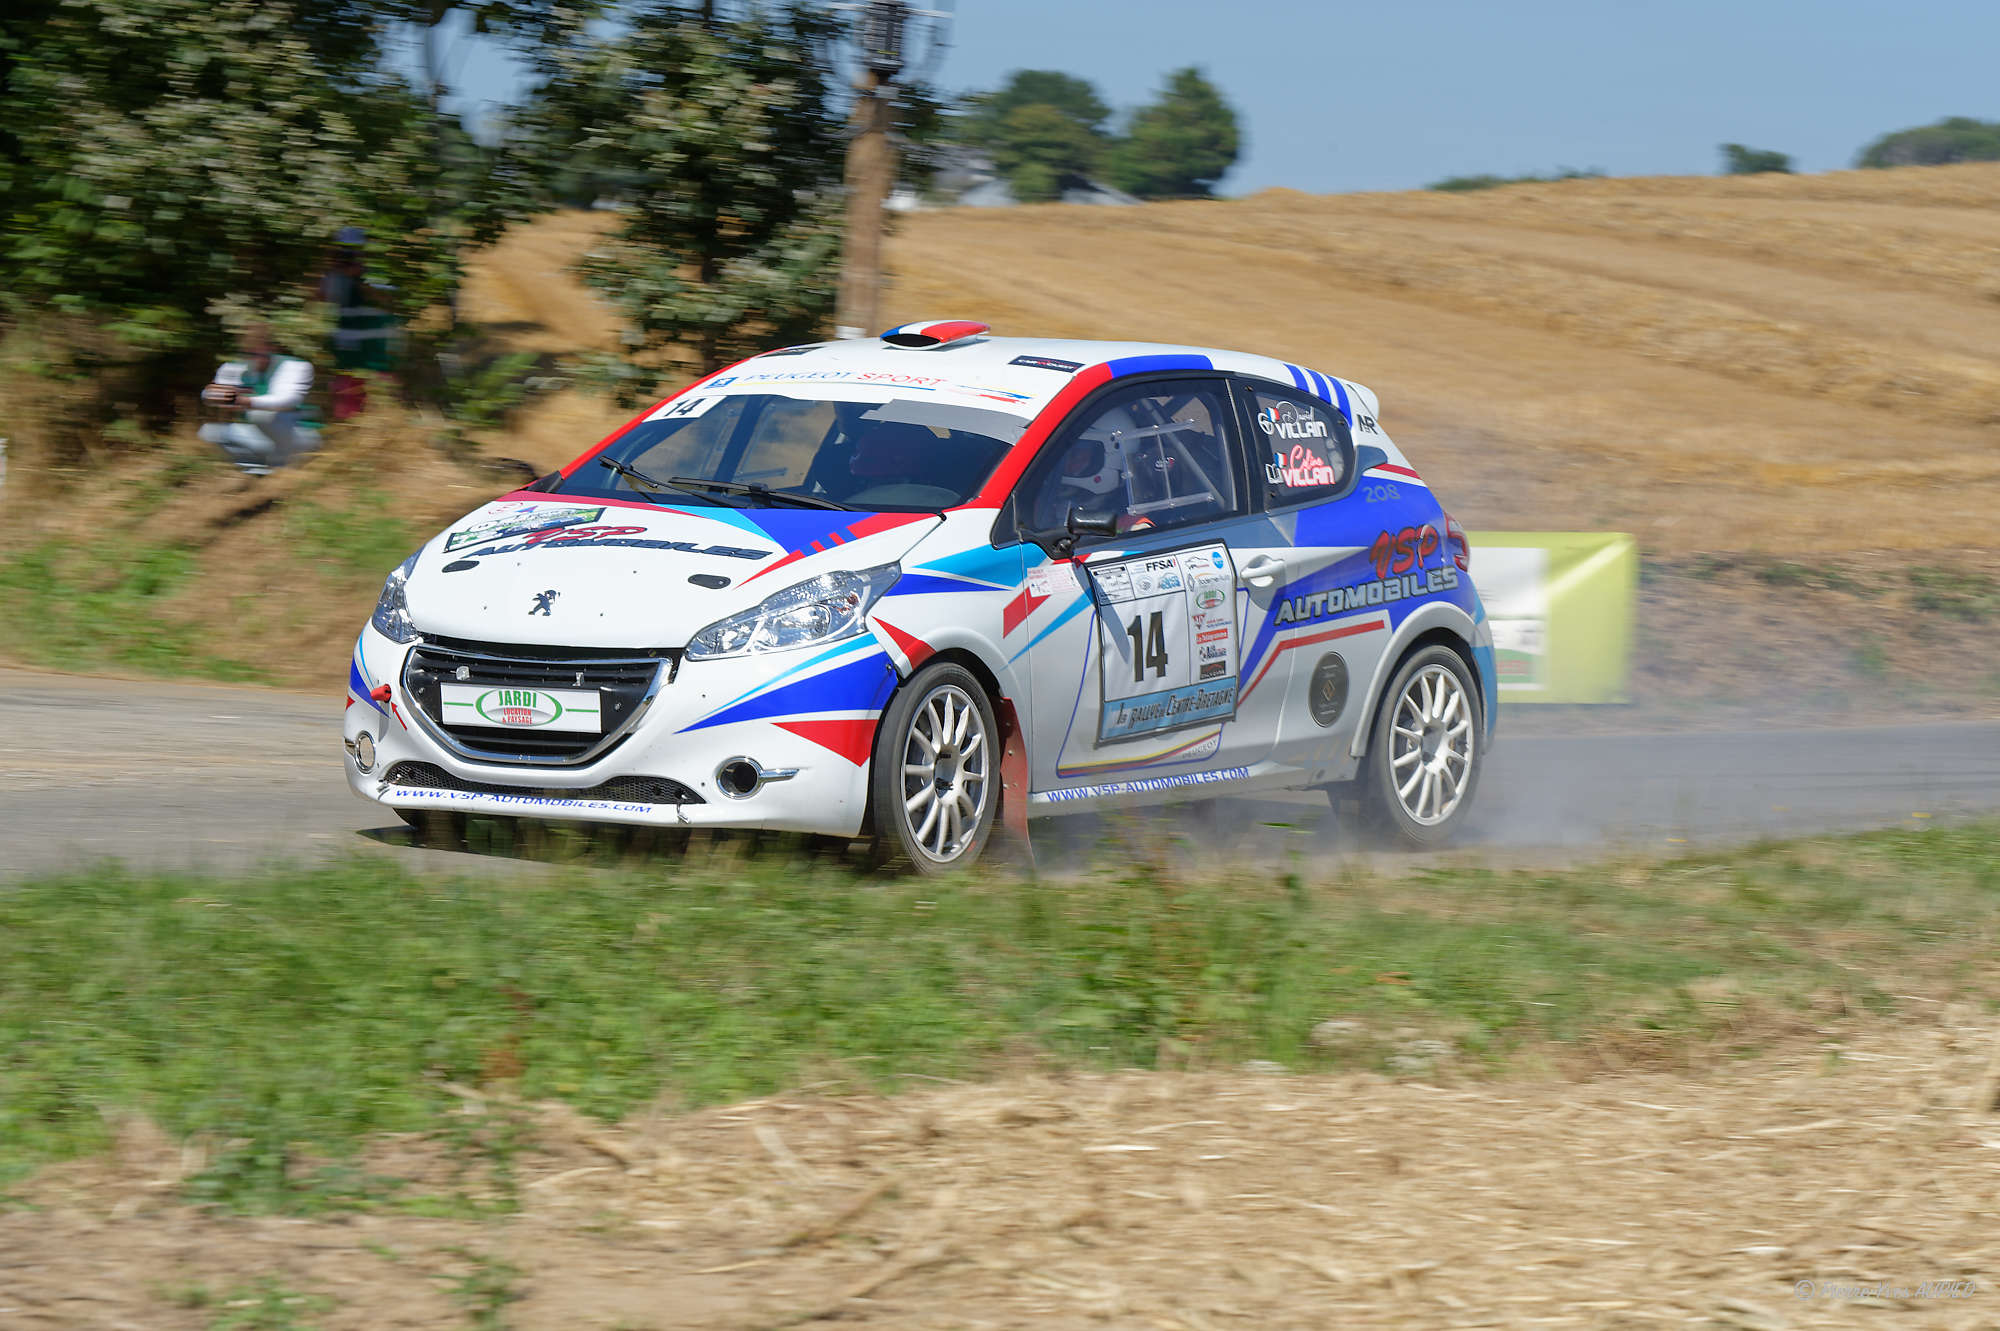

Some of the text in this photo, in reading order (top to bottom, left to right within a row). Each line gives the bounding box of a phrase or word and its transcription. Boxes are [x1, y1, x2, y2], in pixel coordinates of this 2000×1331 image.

[857, 373, 947, 386] SPORT
[664, 398, 707, 417] 14
[1362, 483, 1402, 503] 208
[523, 526, 648, 545] VSP
[460, 538, 773, 560] AUTOMOBILES
[1369, 524, 1440, 580] VSP
[1146, 559, 1175, 572] FFSA
[1273, 566, 1459, 626] AUTOMOBILES
[1127, 611, 1168, 682] 14
[499, 690, 537, 708] JARDI
[503, 708, 532, 716] LOCATION
[507, 715, 533, 725] PAYSAGE
